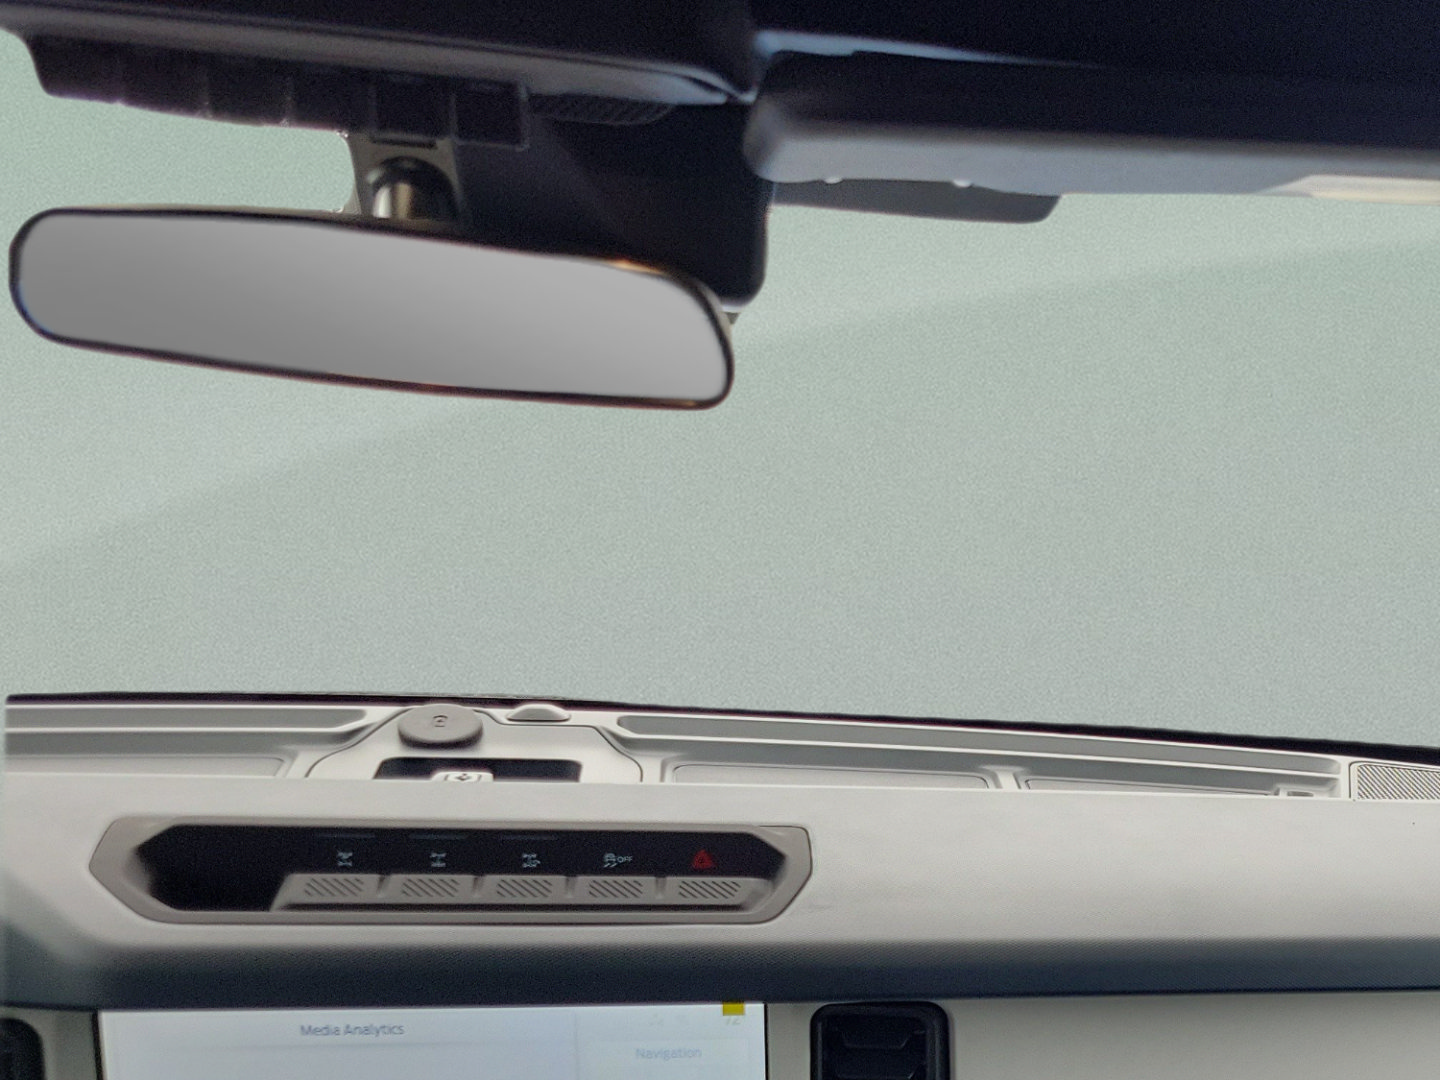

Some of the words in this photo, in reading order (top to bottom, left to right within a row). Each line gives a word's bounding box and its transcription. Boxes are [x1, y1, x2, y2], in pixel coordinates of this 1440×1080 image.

[300, 1024, 341, 1036] Media
[343, 1023, 405, 1038] Analytics
[636, 1048, 702, 1061] Navigation
